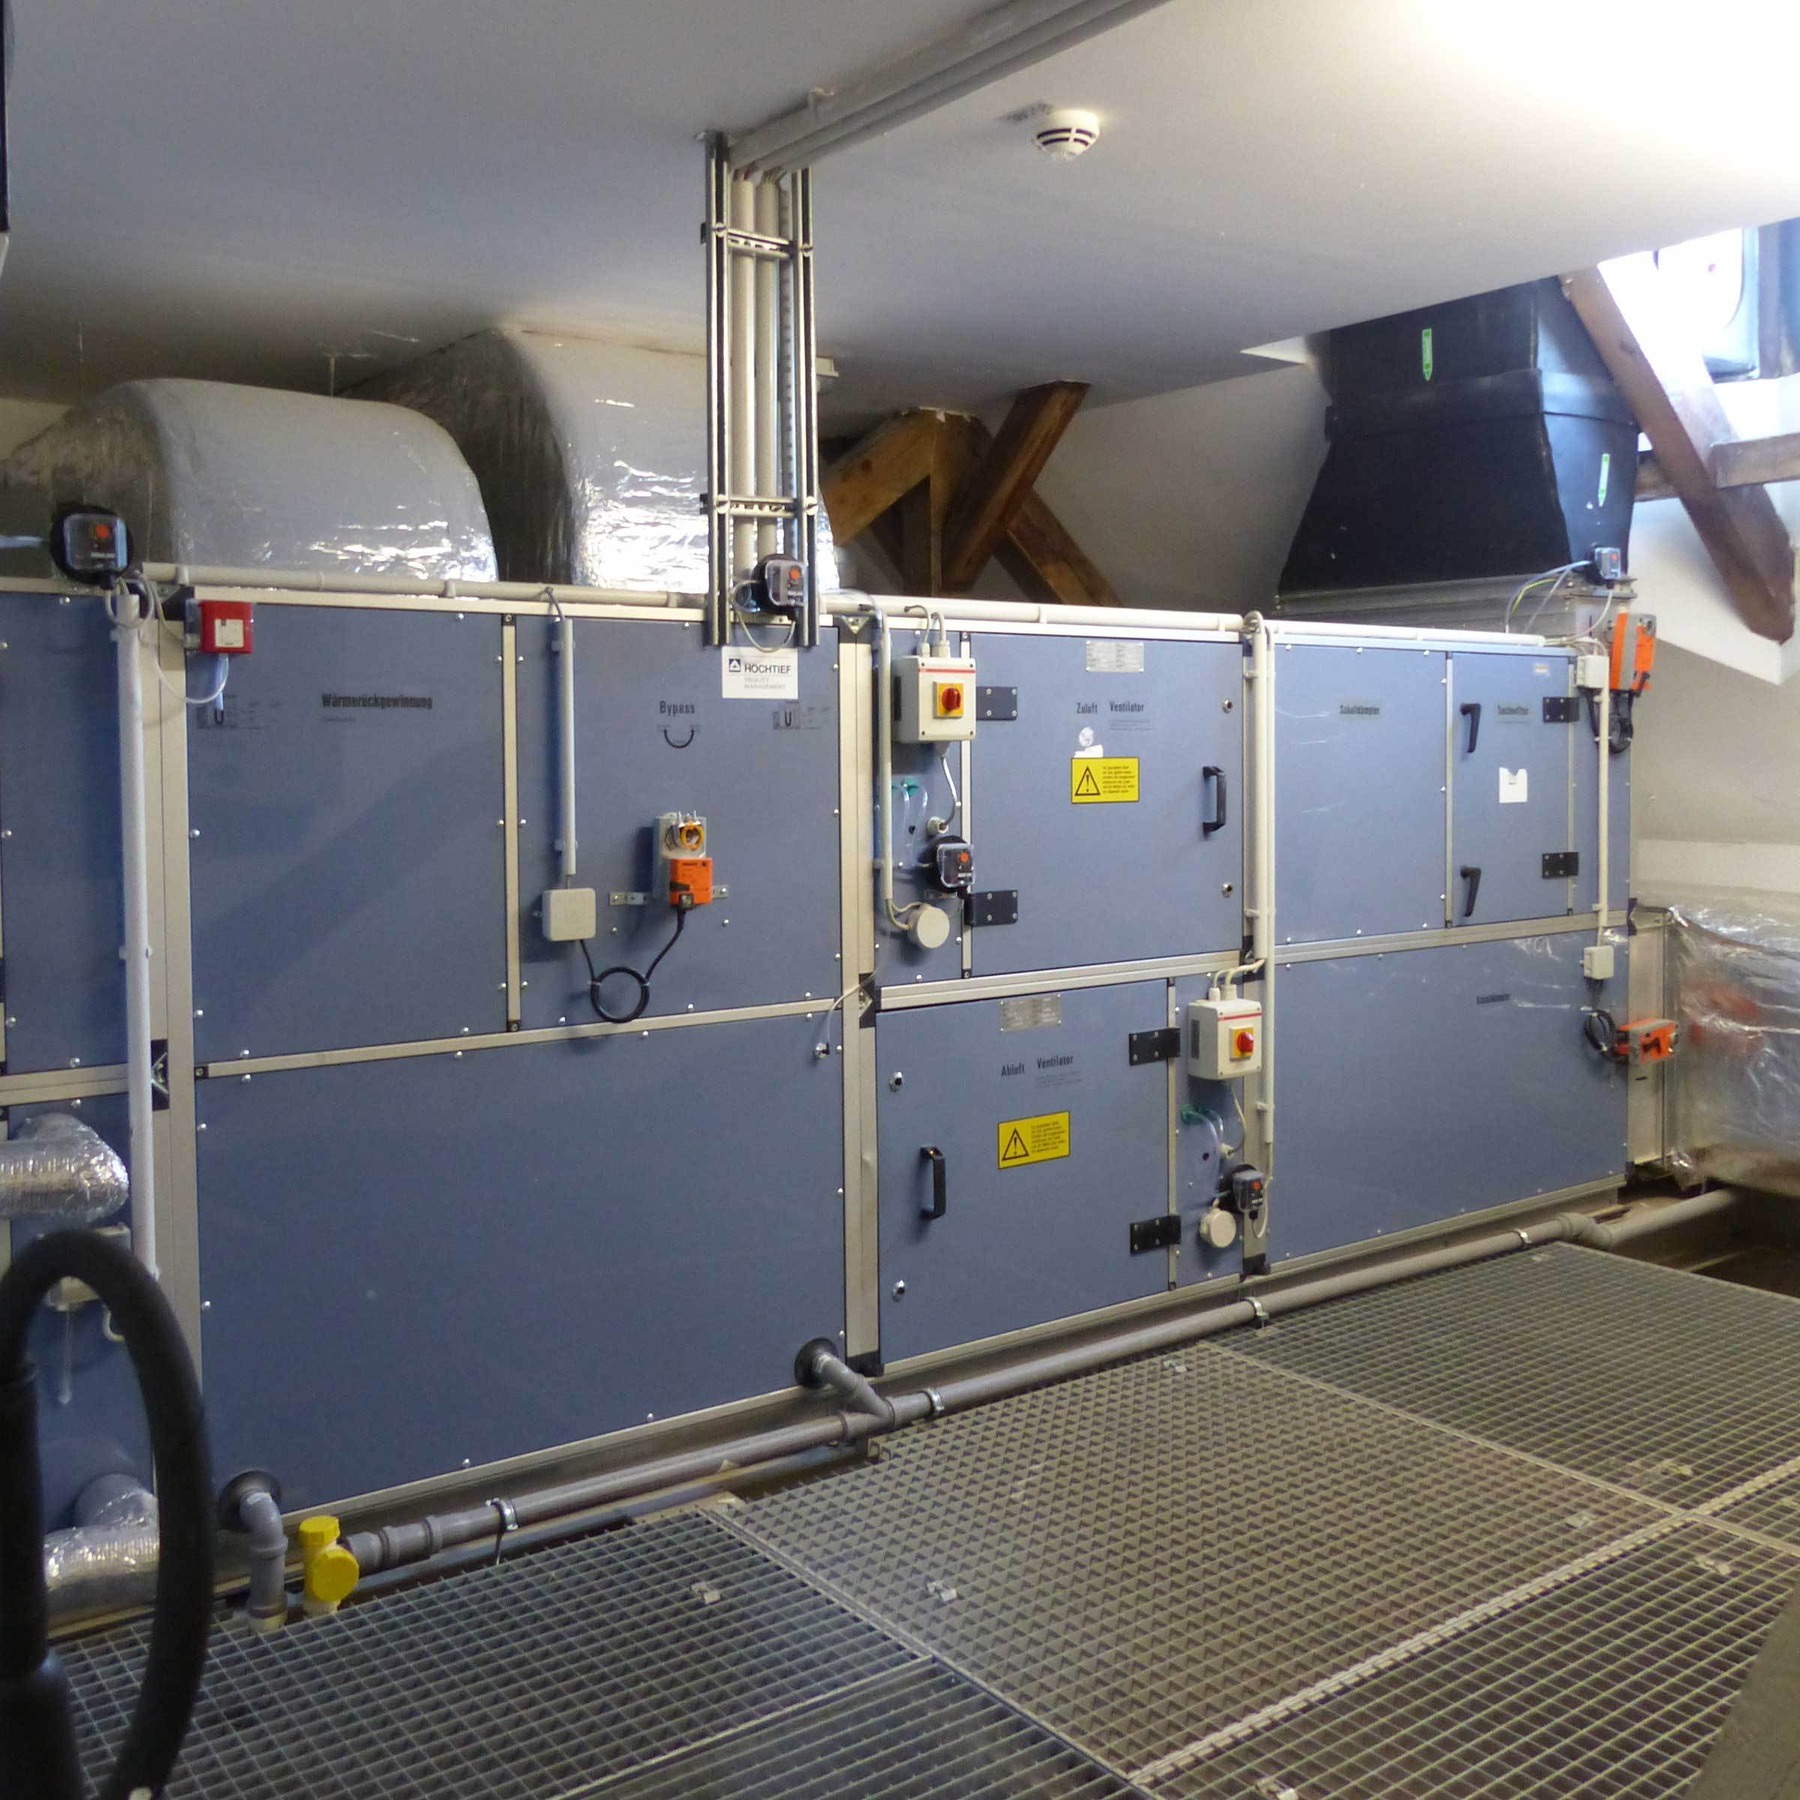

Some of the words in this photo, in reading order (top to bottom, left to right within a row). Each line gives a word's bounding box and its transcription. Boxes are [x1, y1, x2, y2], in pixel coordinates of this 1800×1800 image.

[744, 663, 791, 674] HOCHTIEF
[321, 693, 433, 710] Wärmerückgewinnung
[659, 700, 695, 717] Bypass
[1076, 702, 1098, 714] Zuluft
[1109, 701, 1144, 712] Ventilator
[1037, 1054, 1073, 1069] Ventilator
